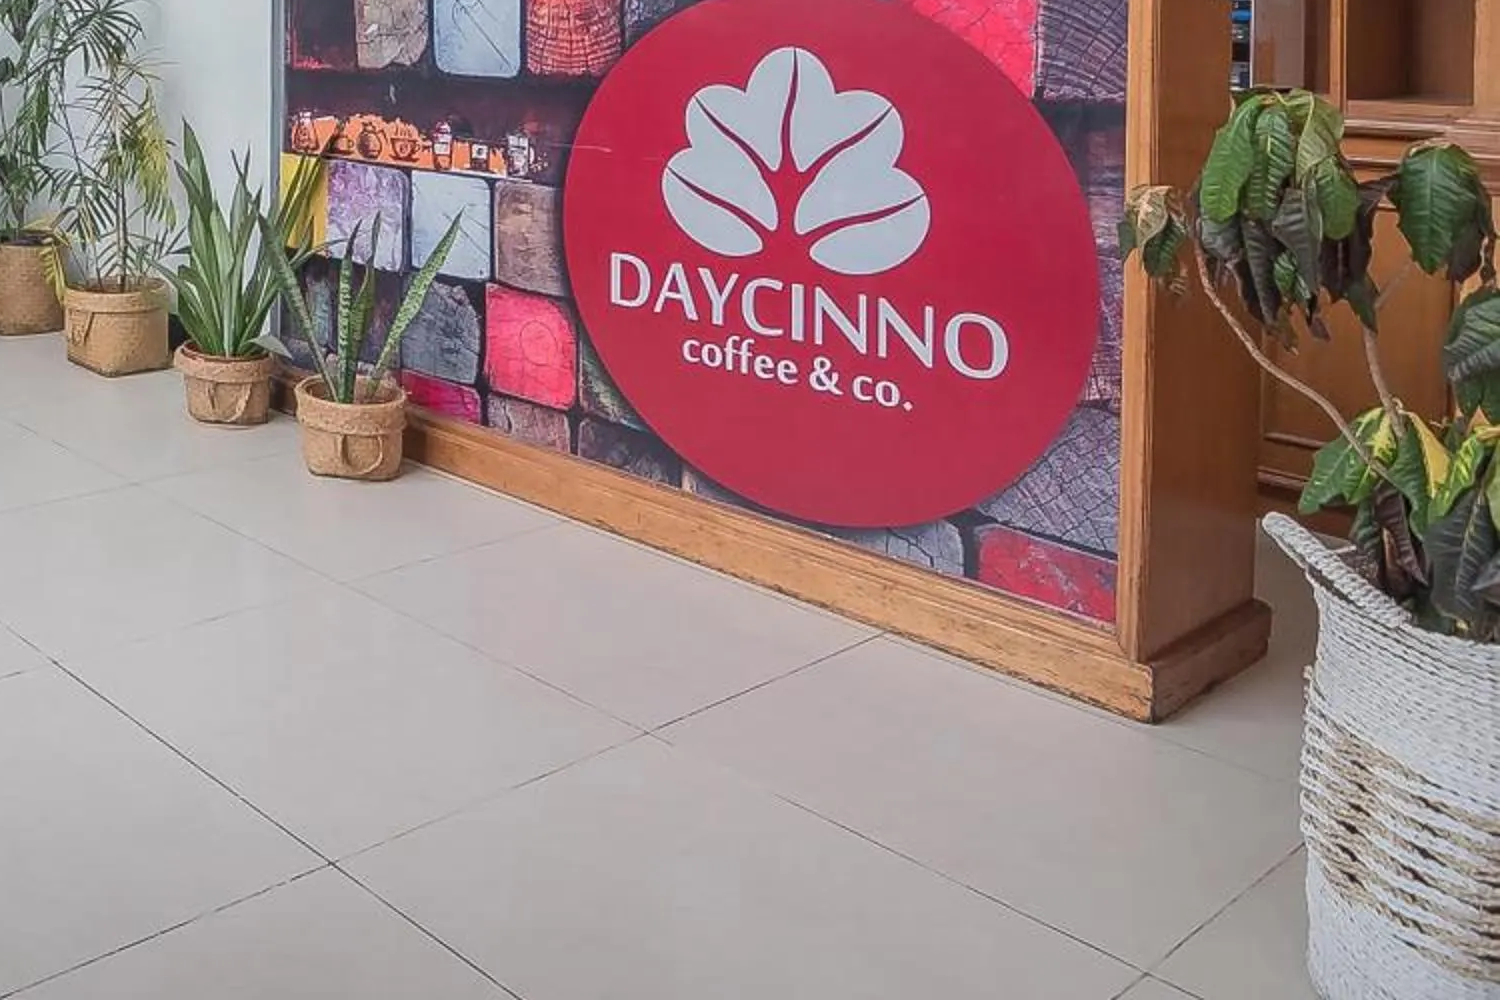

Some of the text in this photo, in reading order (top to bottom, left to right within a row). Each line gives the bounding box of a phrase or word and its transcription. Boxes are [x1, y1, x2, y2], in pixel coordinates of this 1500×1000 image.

[609, 251, 1010, 381] DAYCINNO
[682, 334, 914, 411] coffee & co.
